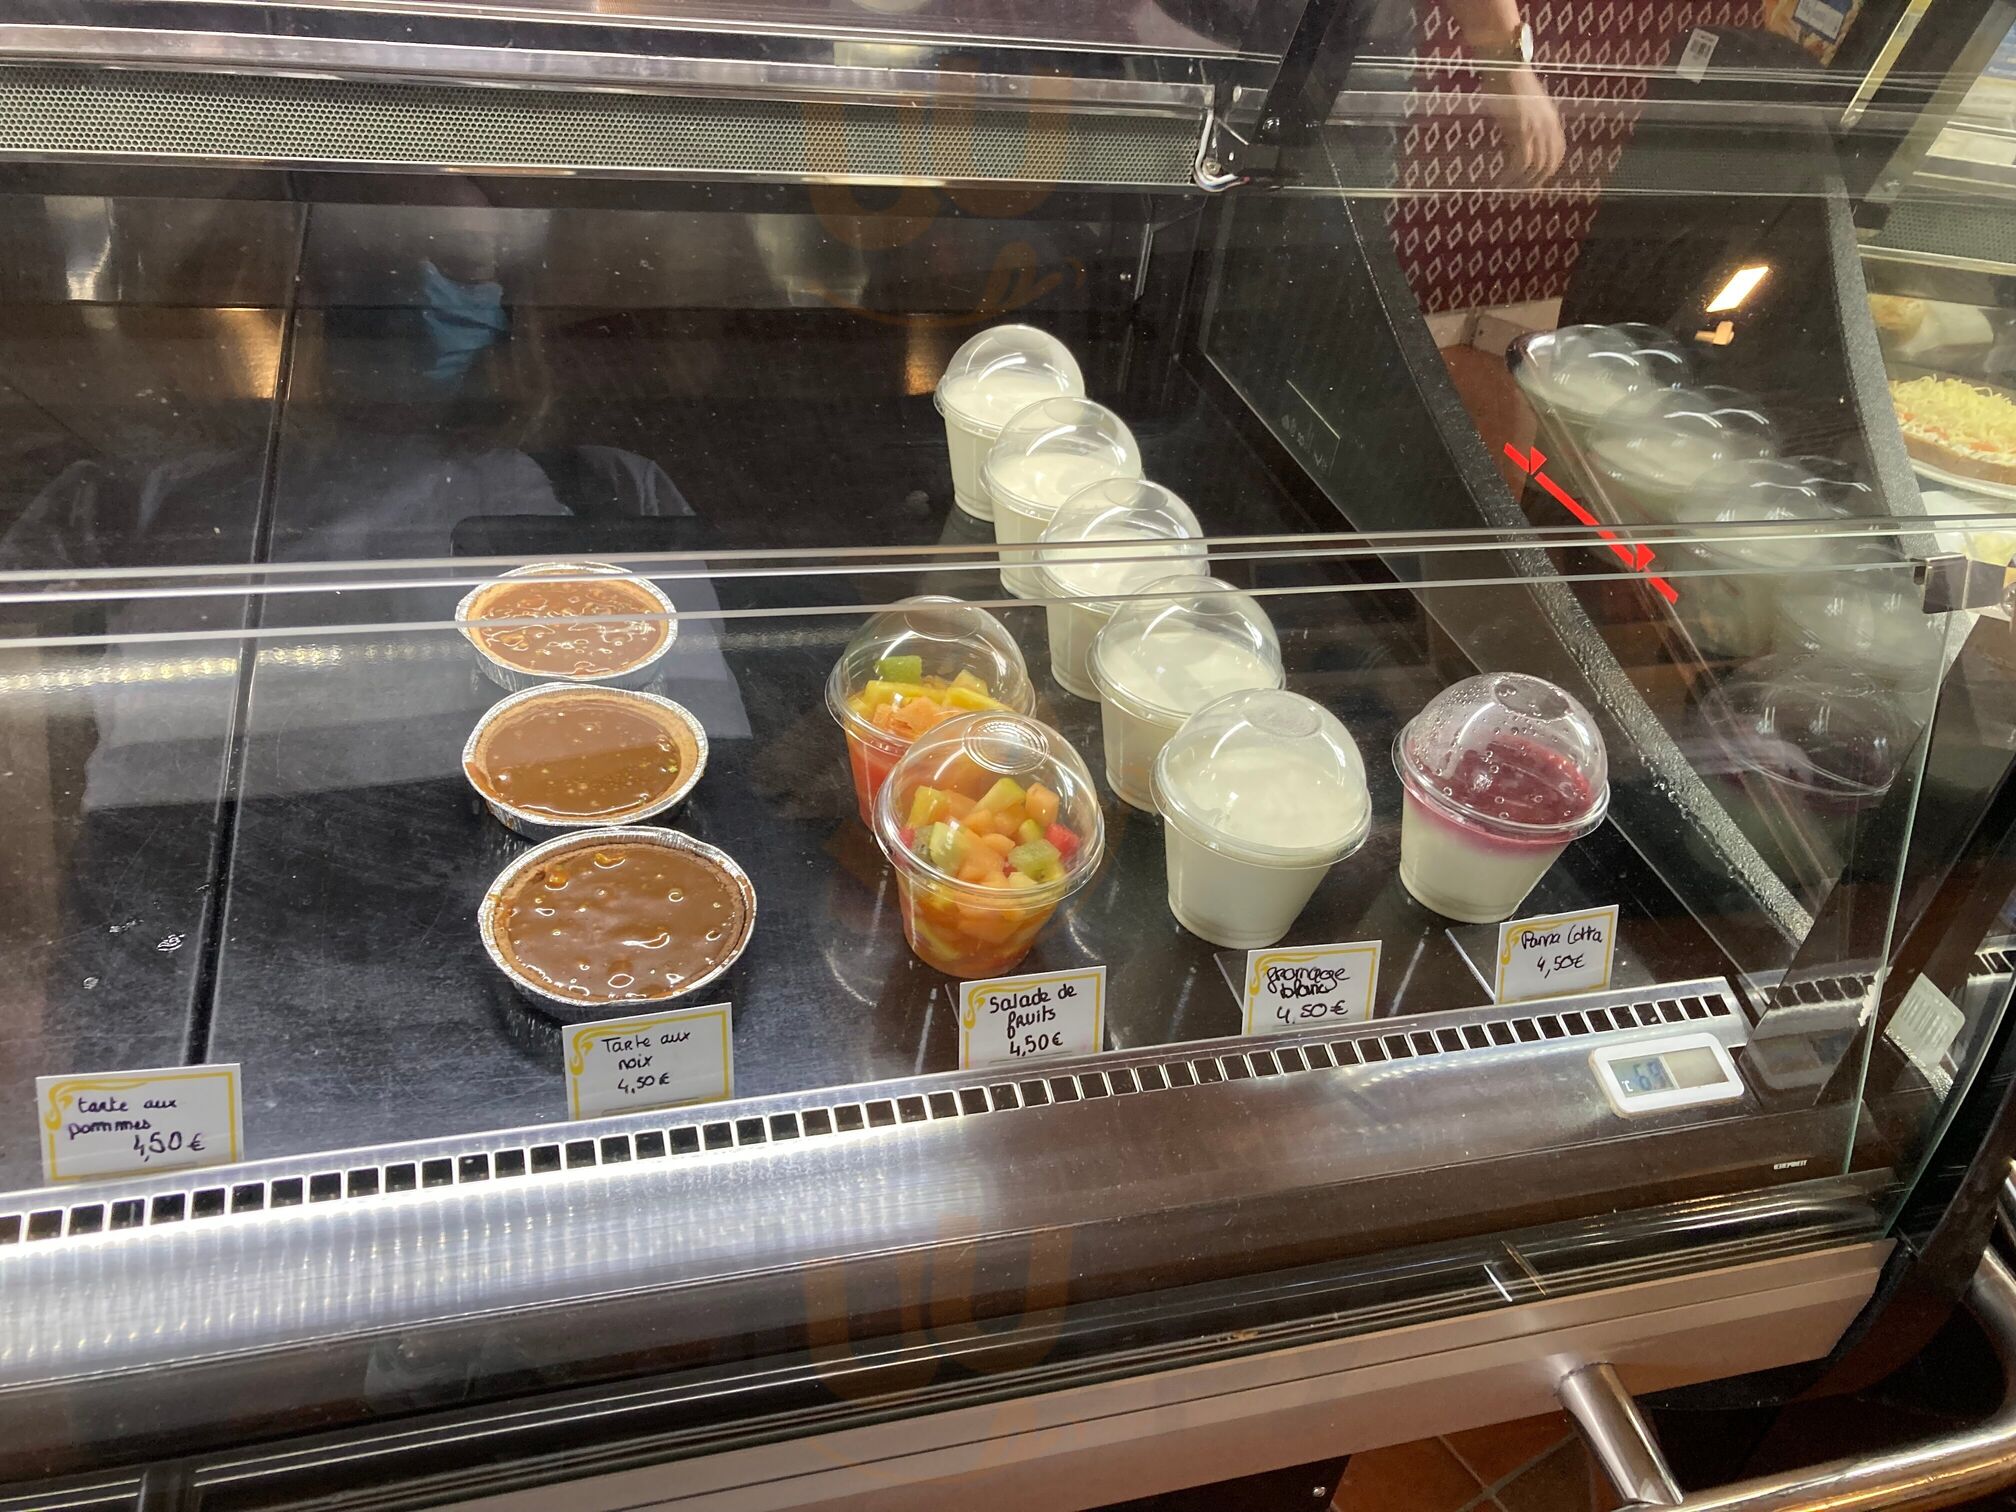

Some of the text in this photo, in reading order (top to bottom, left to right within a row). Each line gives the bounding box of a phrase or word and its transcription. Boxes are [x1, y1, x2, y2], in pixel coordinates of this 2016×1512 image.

[1567, 925, 1603, 944] Cotta
[989, 983, 1078, 1014] Salade de
[1280, 980, 1332, 999] blanc
[1006, 1005, 1057, 1040] fruits
[601, 1031, 691, 1053] Tarte aux
[1009, 1032, 1064, 1057] 4,50€
[618, 1053, 654, 1071] noix
[78, 1096, 178, 1113] tarte aux
[68, 1120, 152, 1141] pommes
